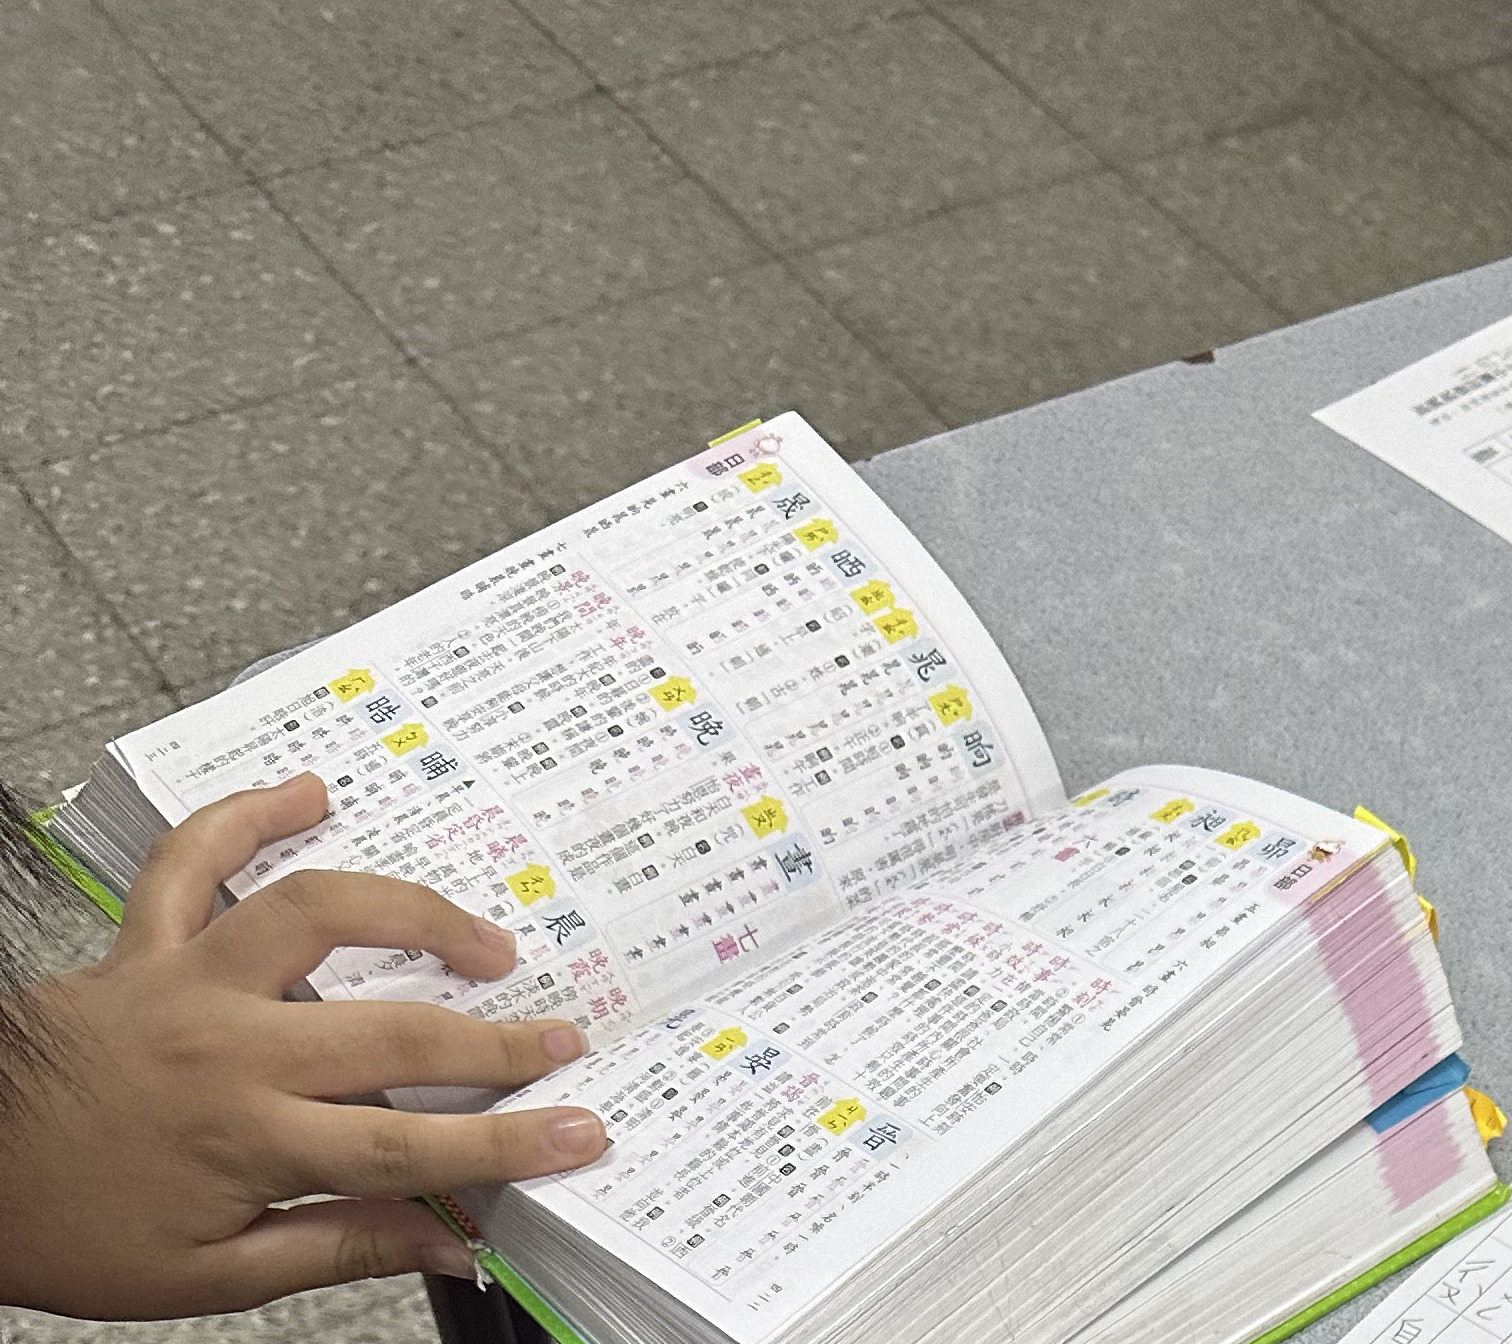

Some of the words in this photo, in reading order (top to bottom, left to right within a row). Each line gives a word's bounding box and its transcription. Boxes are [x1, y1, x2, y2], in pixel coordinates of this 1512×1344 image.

[704, 452, 747, 478] 日部
[771, 491, 812, 522] 晟
[829, 548, 867, 579] 晒
[906, 646, 948, 684] 晁
[688, 709, 725, 748] 晚
[962, 728, 995, 769] 晌
[773, 842, 814, 884] 晝
[1271, 862, 1314, 892] 日部
[541, 908, 587, 948] 晨
[738, 1045, 782, 1077] 晏
